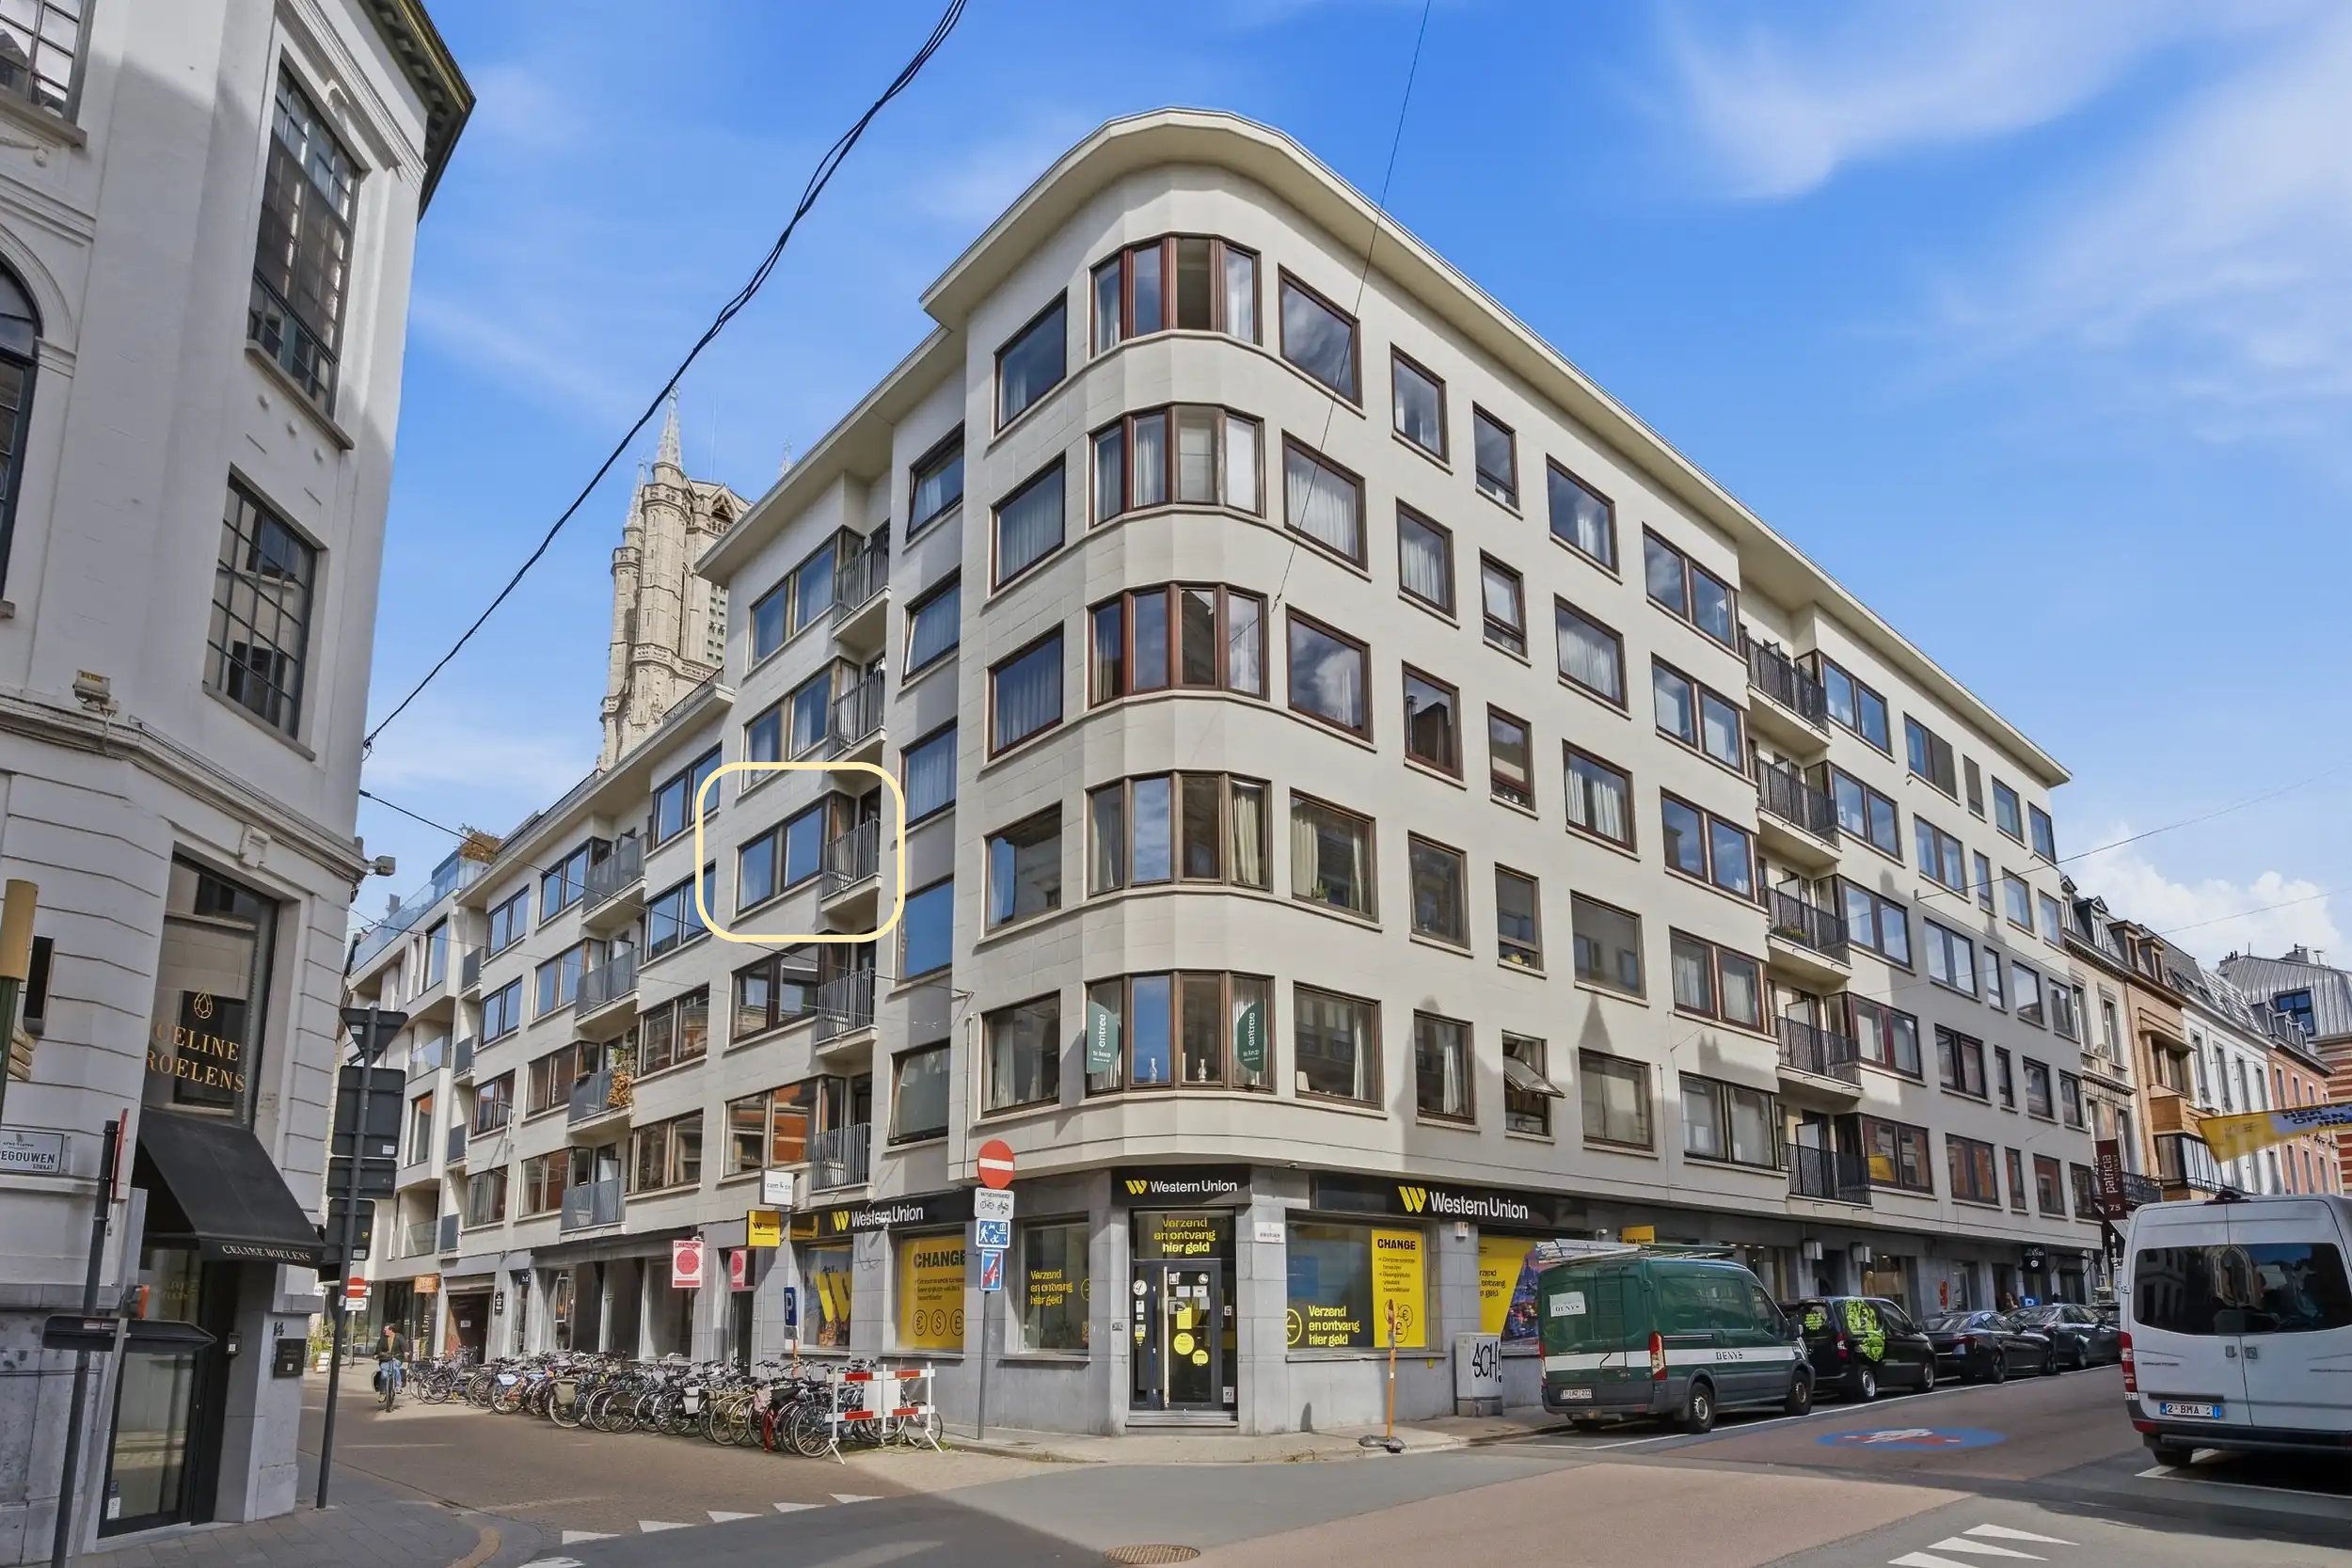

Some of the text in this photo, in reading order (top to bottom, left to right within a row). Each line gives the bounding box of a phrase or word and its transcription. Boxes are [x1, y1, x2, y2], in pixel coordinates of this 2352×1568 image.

[1098, 1013, 1106, 1048] entree
[156, 1022, 240, 1061] CELINE
[147, 1050, 245, 1092] ROELENS
[0, 1150, 55, 1164] EGOUWEN
[2102, 1154, 2118, 1194] patricia
[1151, 1180, 1200, 1193] Western
[1201, 1180, 1238, 1192] Union
[1429, 1191, 1488, 1216] Western
[1489, 1196, 1529, 1220] Union
[850, 1210, 892, 1227] Western
[893, 1204, 924, 1223] Union
[1162, 1217, 1208, 1227] Verzend
[1169, 1229, 1216, 1241] ontvang
[1162, 1243, 1210, 1255] hier geld
[1377, 1238, 1416, 1250] CHANGE
[222, 1245, 264, 1257] CELINE
[914, 1249, 966, 1269] CHANGE
[786, 1293, 793, 1320] P
[1308, 1305, 1346, 1318] Verzend
[1309, 1320, 1360, 1333] en ontvang
[1309, 1334, 1348, 1347] hier geld
